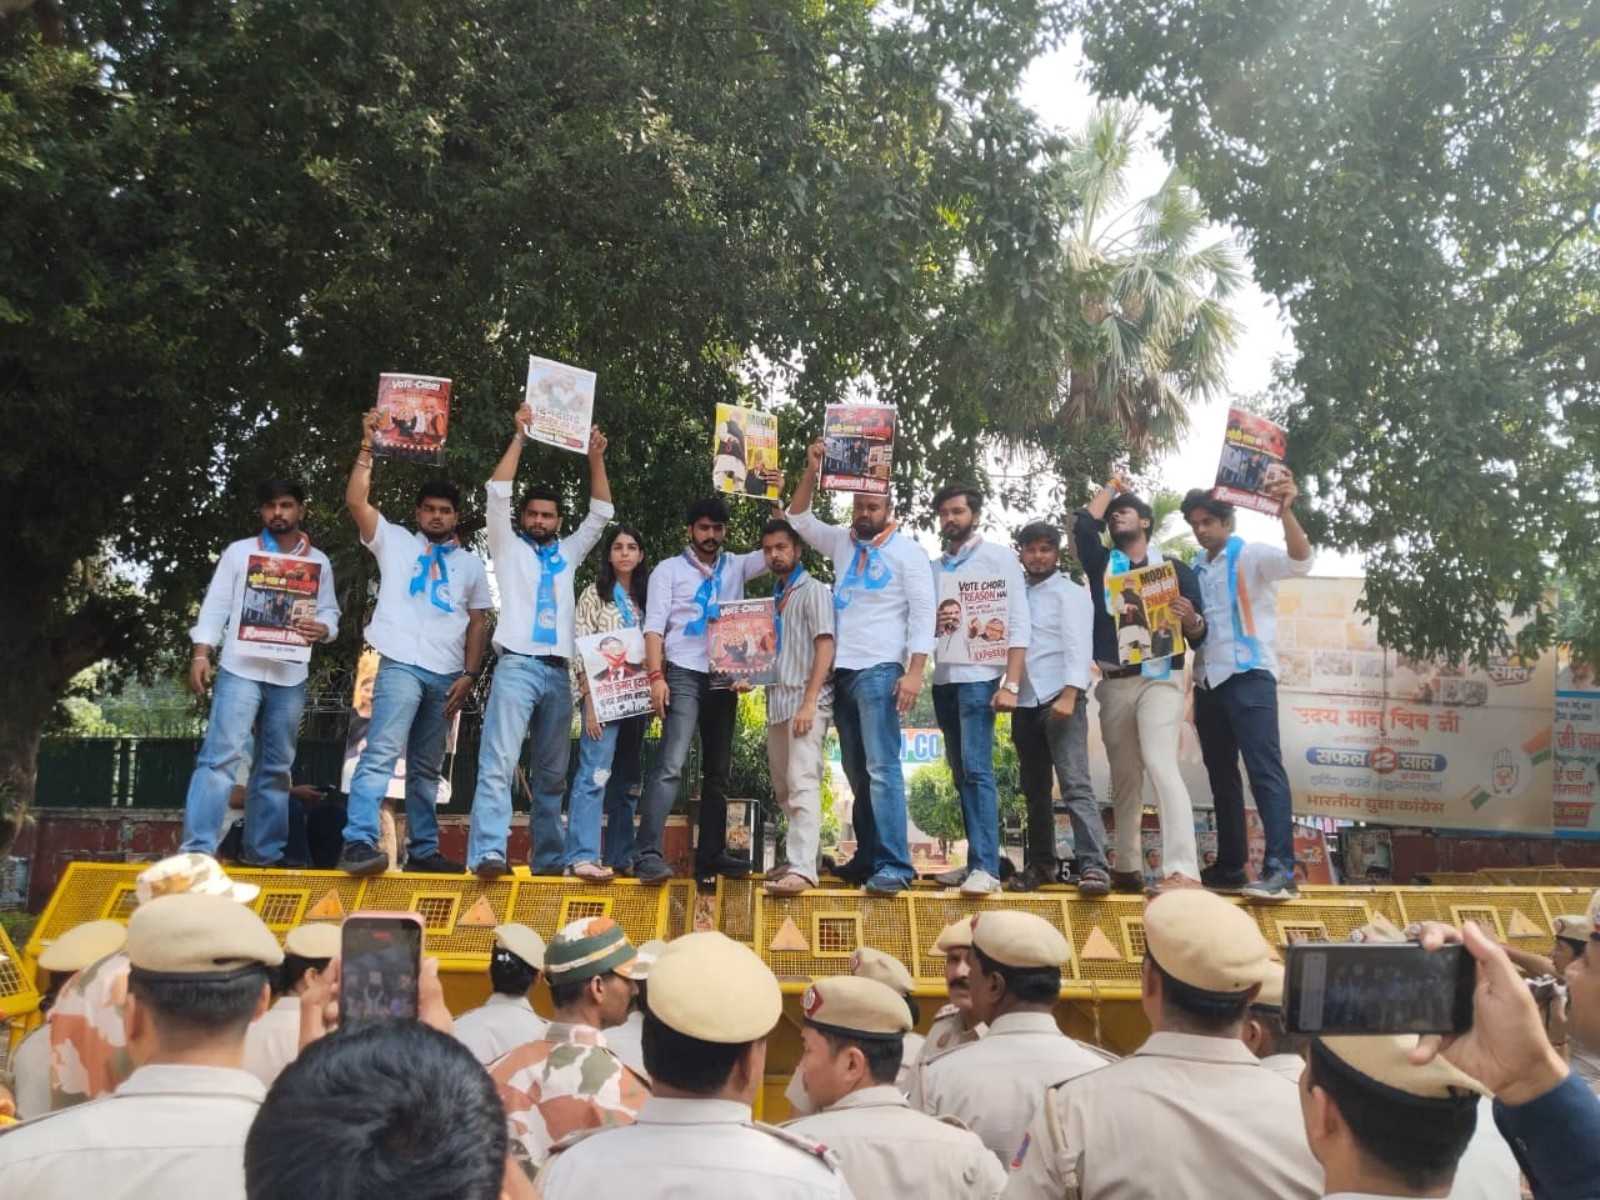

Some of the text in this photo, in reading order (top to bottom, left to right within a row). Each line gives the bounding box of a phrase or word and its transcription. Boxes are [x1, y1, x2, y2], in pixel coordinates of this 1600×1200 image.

[958, 580, 1006, 591] VOTE CHORI
[959, 591, 996, 601] TREASON
[1292, 707, 1340, 725] उदय
[1435, 709, 1461, 733] जी
[1316, 749, 1437, 771] सफल 2 साल
[1306, 793, 1446, 814] भारतीय युवा कांग्रेस
[1061, 861, 1071, 881] 5
